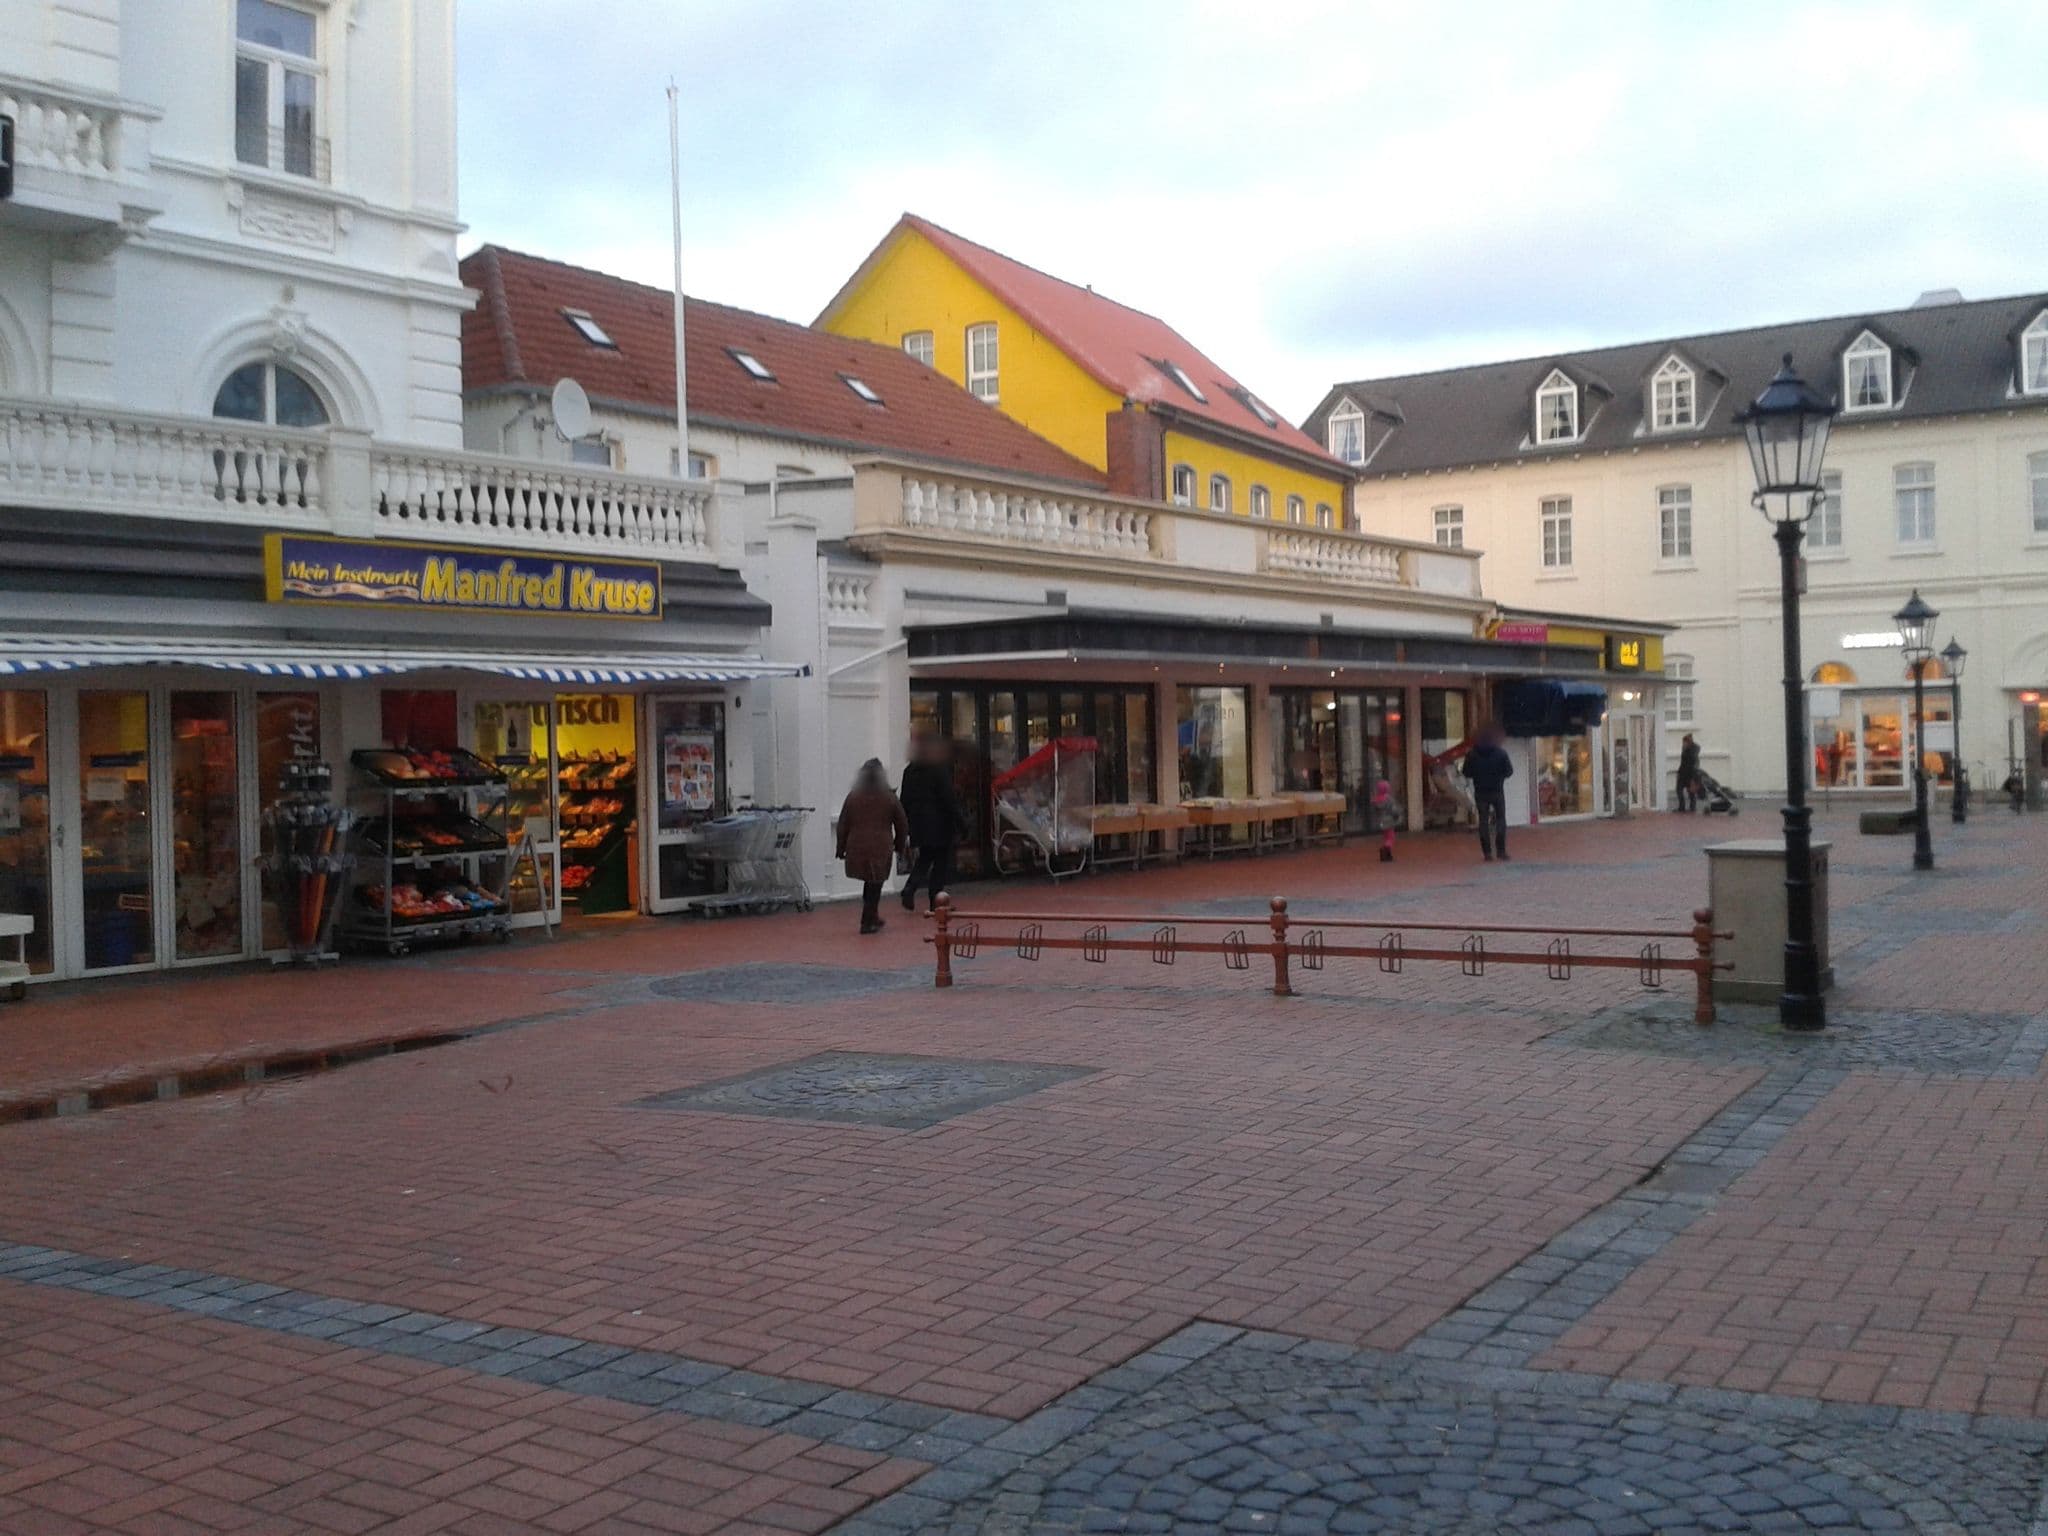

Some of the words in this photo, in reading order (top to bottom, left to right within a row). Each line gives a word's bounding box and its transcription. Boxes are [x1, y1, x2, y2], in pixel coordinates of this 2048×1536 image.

[288, 560, 330, 582] Mein
[333, 563, 420, 587] Inselmarkt
[421, 555, 565, 608] Manfred
[569, 566, 655, 614] Kruse
